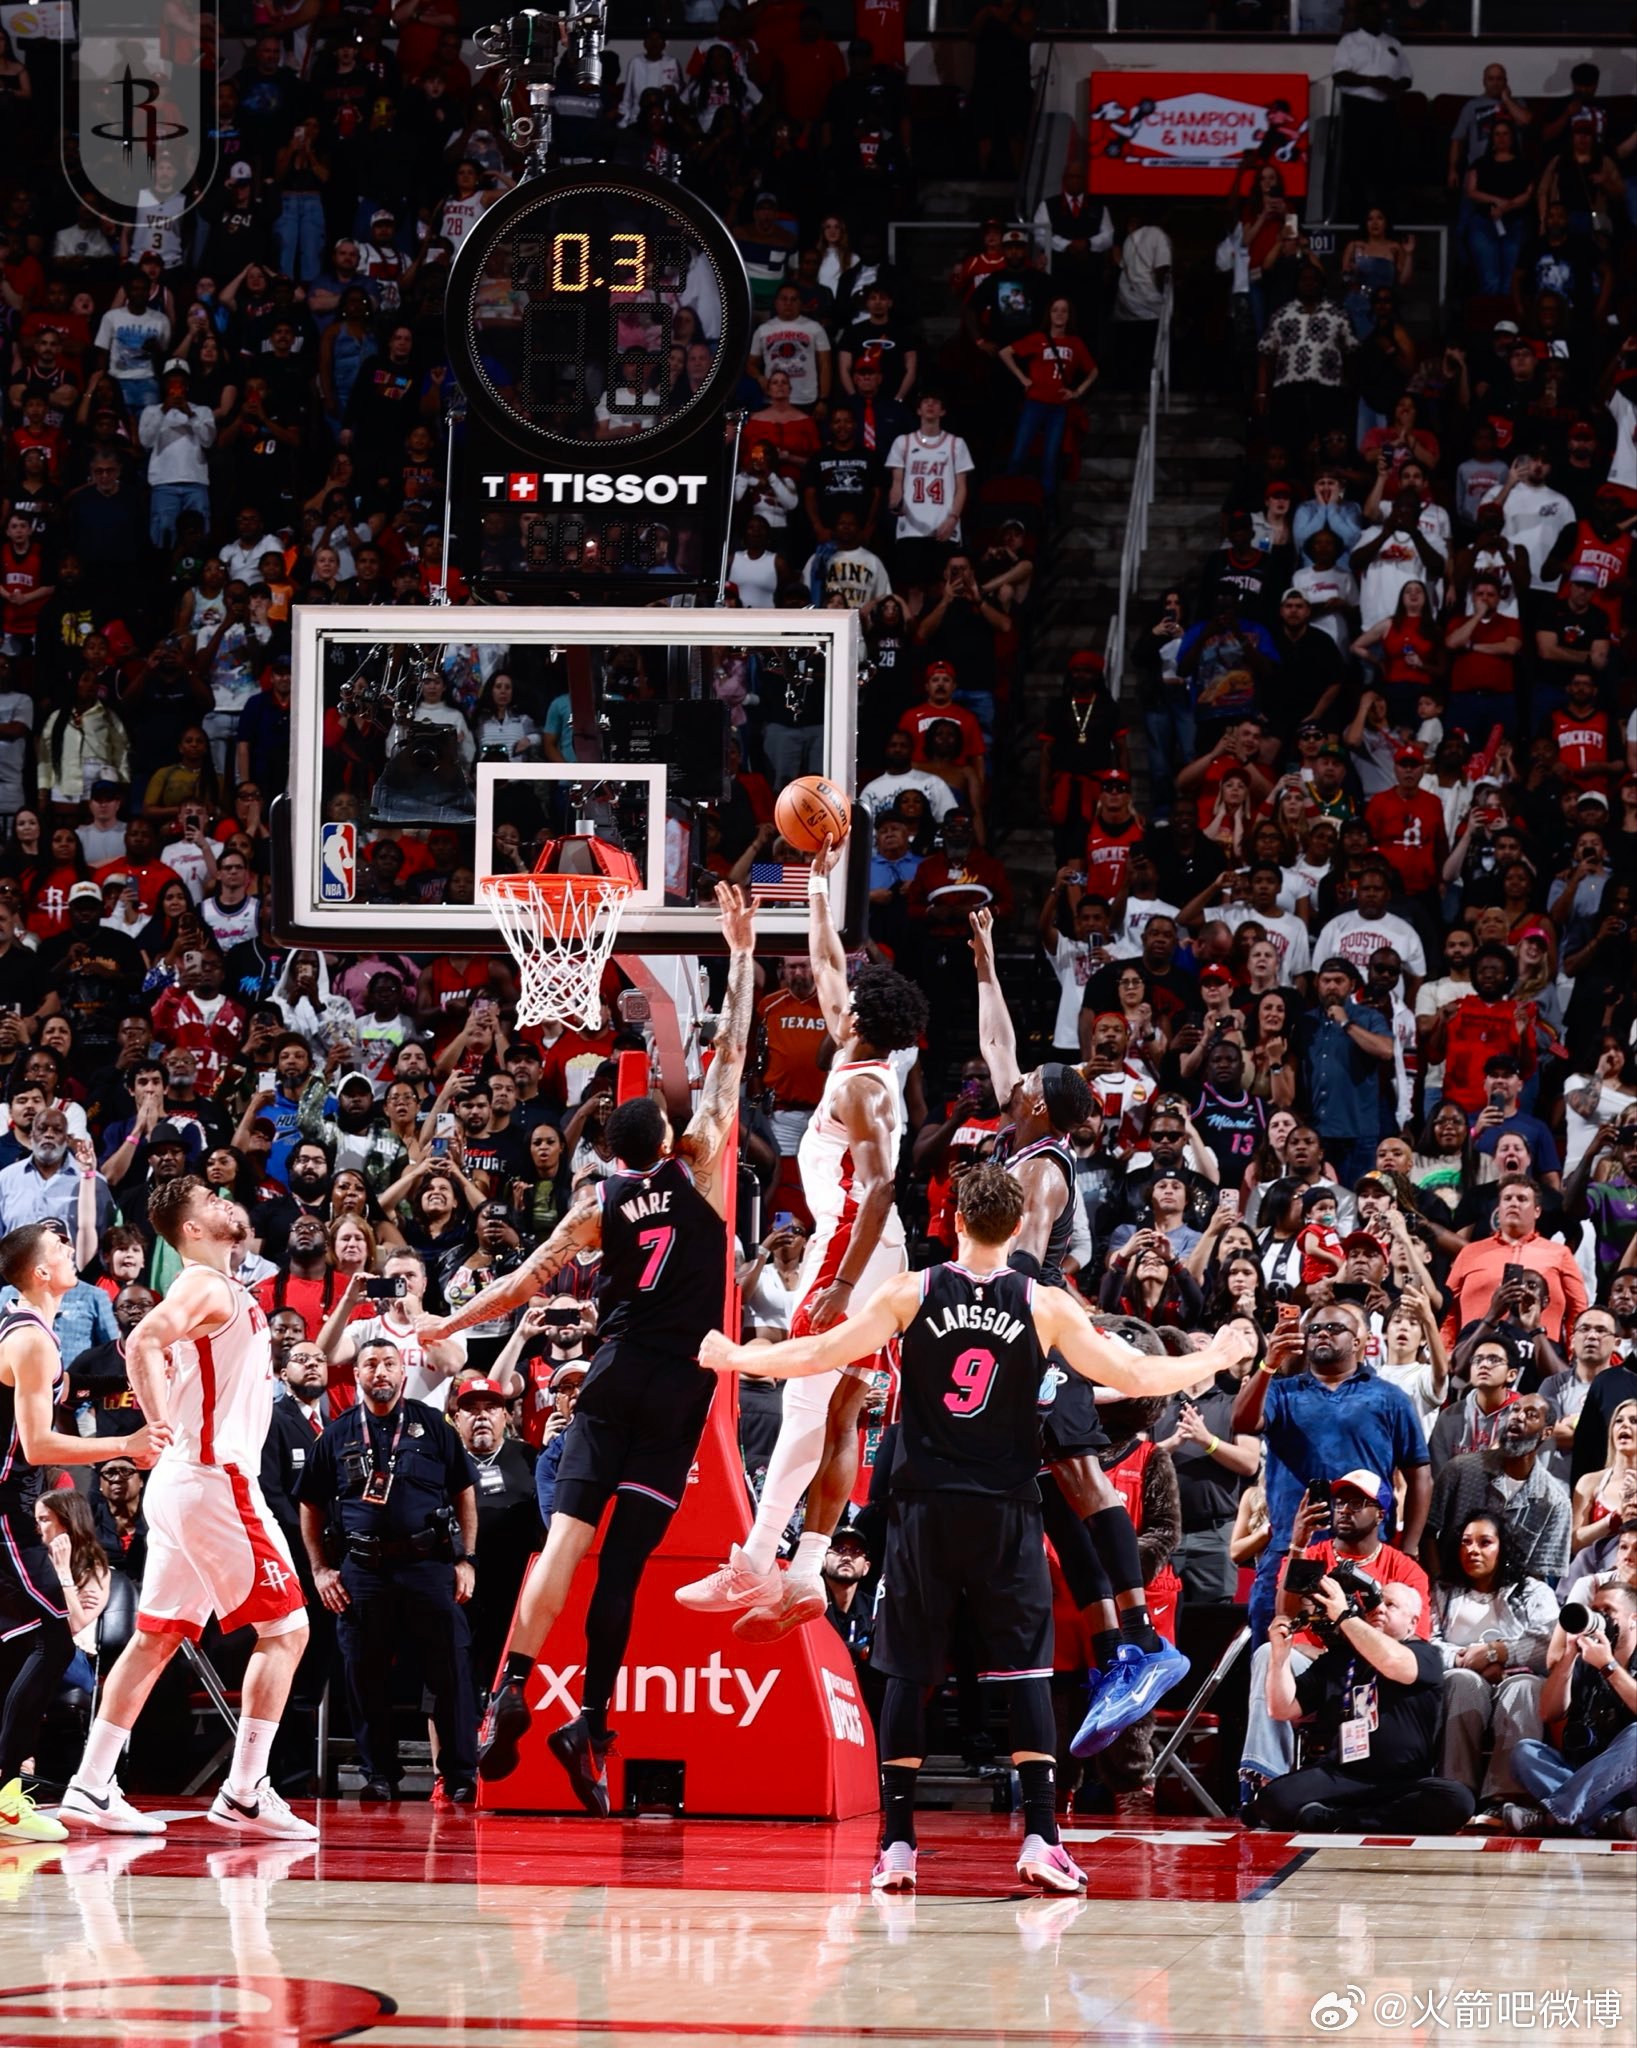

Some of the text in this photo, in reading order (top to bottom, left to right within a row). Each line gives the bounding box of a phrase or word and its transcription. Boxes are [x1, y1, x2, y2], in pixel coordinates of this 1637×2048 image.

[1144, 112, 1255, 127] CHAMPION
[1161, 130, 1237, 146] & NASH
[446, 217, 464, 236] 28
[151, 233, 163, 250] 3
[1310, 235, 1330, 251] 101
[552, 233, 646, 292] 0.3
[912, 459, 948, 476] HEAT
[543, 473, 708, 505] TISSOT
[913, 476, 945, 505] 14
[878, 650, 897, 668] 28
[816, 782, 848, 827] Wilson
[1109, 863, 1121, 887] 7
[325, 883, 342, 897] NBA
[780, 1016, 827, 1032] TEXAS
[1230, 1131, 1256, 1156] 13
[619, 1190, 673, 1225] WARE
[638, 1225, 676, 1291] 7
[926, 1304, 1025, 1345] LARSSON
[944, 1347, 999, 1418] 9
[533, 1650, 782, 1728] xinity
